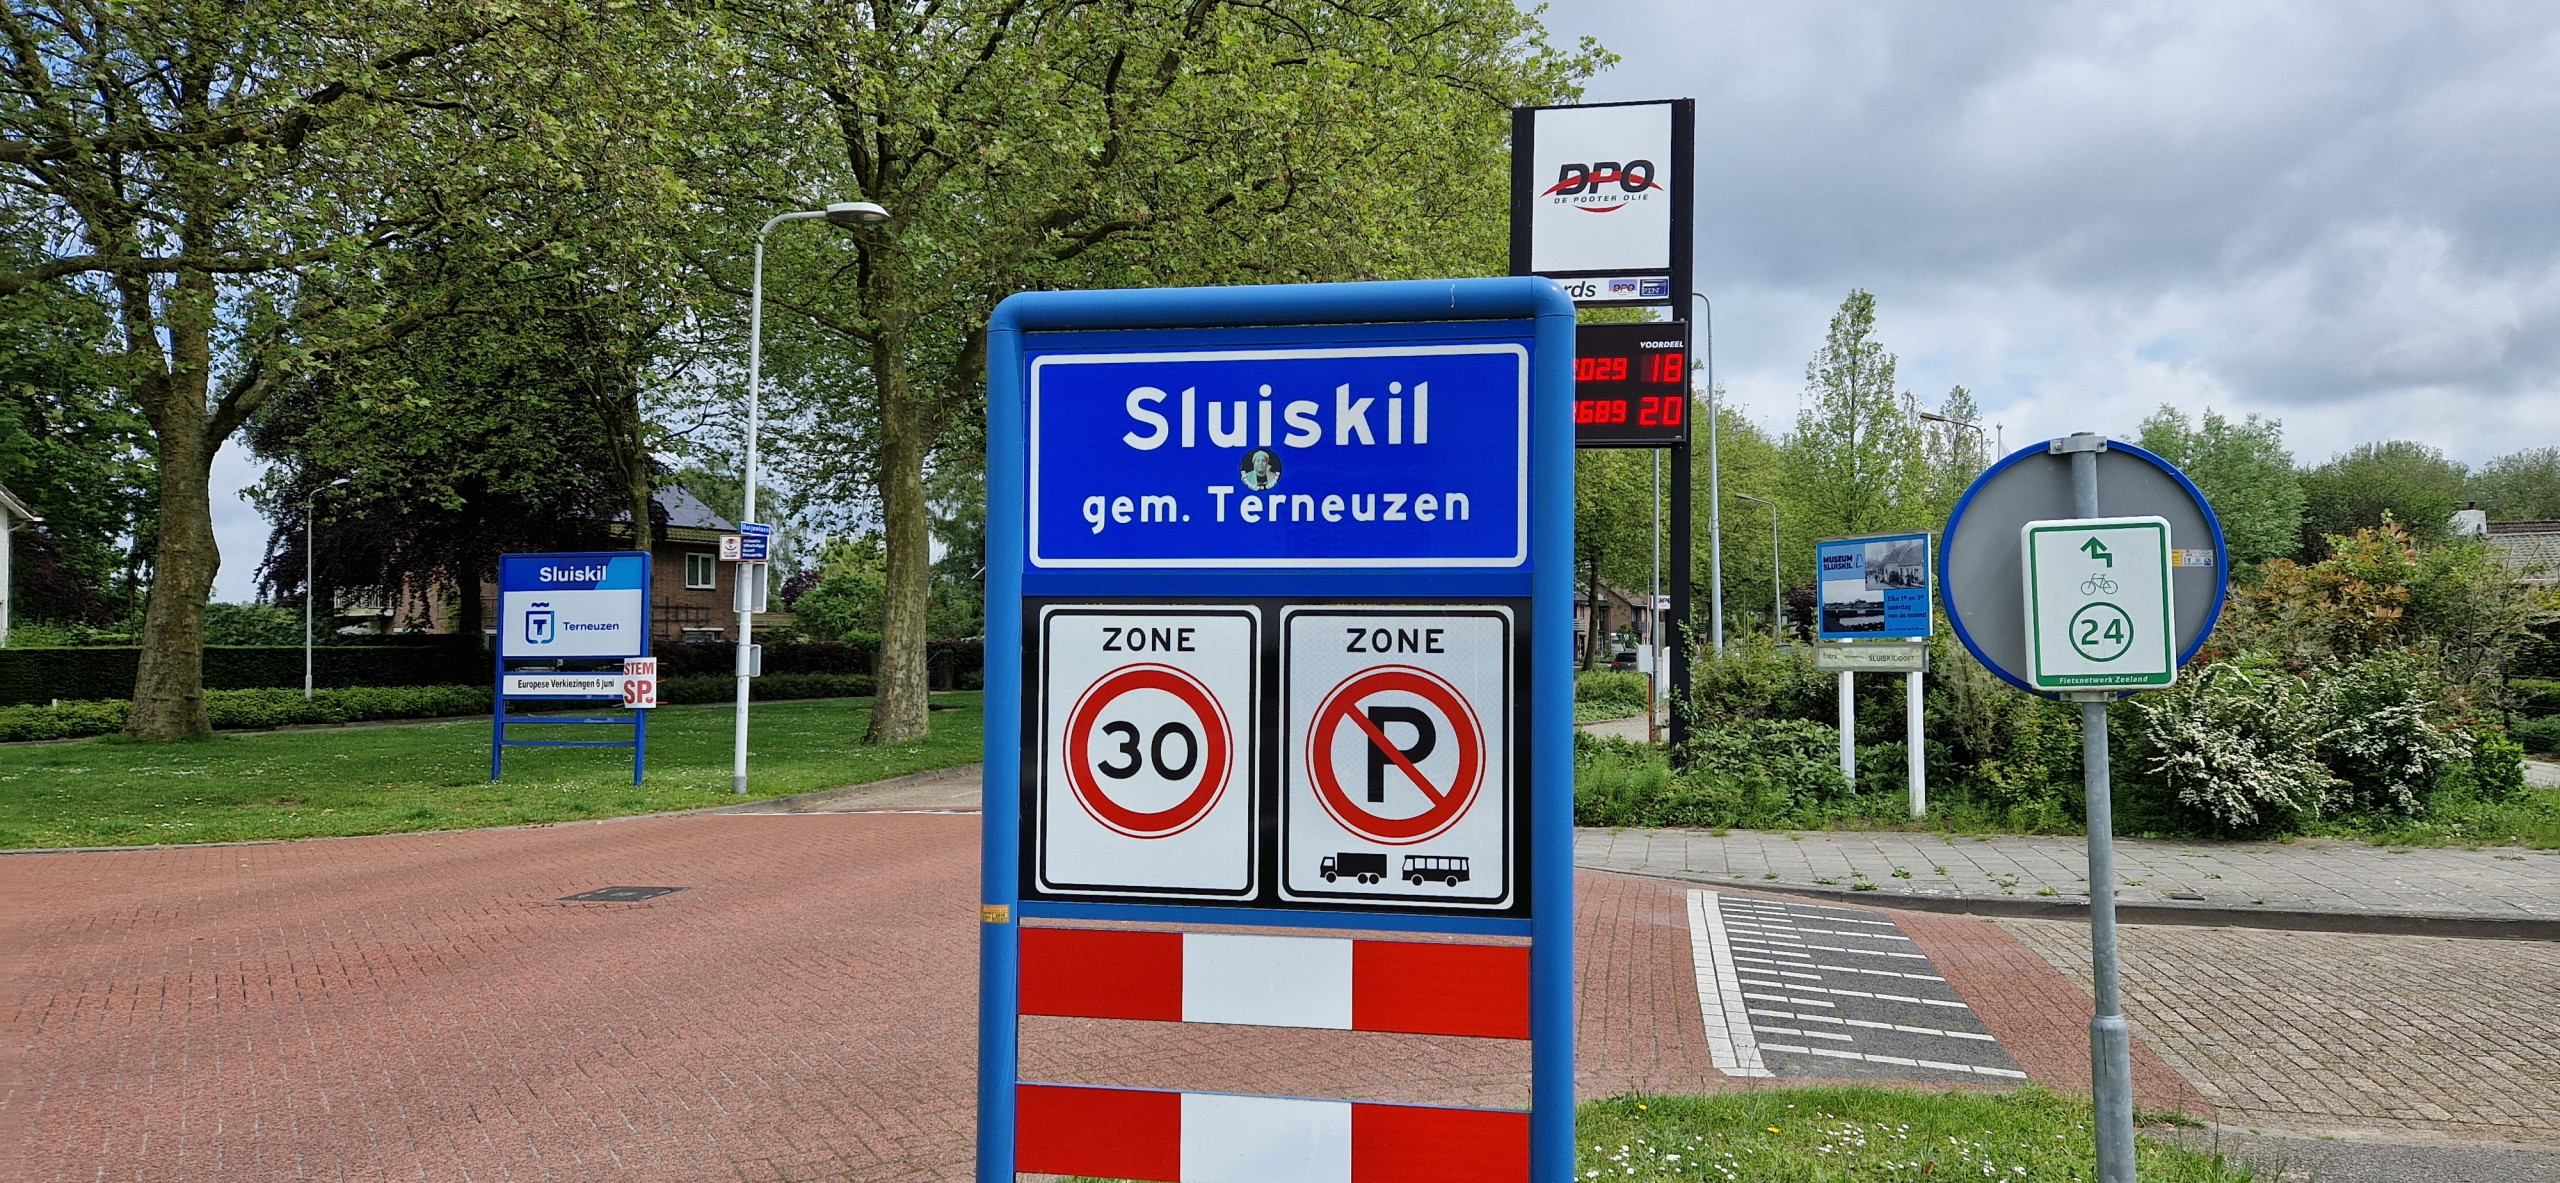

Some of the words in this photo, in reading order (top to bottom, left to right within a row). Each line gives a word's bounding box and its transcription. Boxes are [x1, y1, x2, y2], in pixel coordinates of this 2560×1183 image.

[1556, 159, 1655, 195] DPO
[1574, 195, 1617, 203] POOTER
[1624, 193, 1649, 201] OLIE
[1640, 341, 1684, 349] VOORDEEL
[1652, 354, 1684, 382] 18
[1123, 381, 1429, 451] Sluiskil
[1639, 396, 1683, 425] 20
[1083, 493, 1190, 535] gem.
[1208, 486, 1469, 522] Terneuzen
[1823, 555, 1853, 563] MUSEUM
[1823, 562, 1853, 571] SLUISKIL
[539, 565, 607, 582] Sluiskil
[562, 621, 620, 631] Terneuzen
[2081, 618, 2125, 645] 24
[1102, 627, 1196, 652] ZONE
[1346, 628, 1445, 654] ZONE
[624, 662, 655, 676] STEM
[2059, 676, 2113, 685] Fietsnetwerk
[2115, 675, 2149, 683] Zeeland
[518, 680, 550, 690] Europese
[551, 679, 594, 690] Verkiezingen
[596, 679, 600, 688] 6
[1097, 720, 1198, 780] 30
[1367, 706, 1437, 803] P
